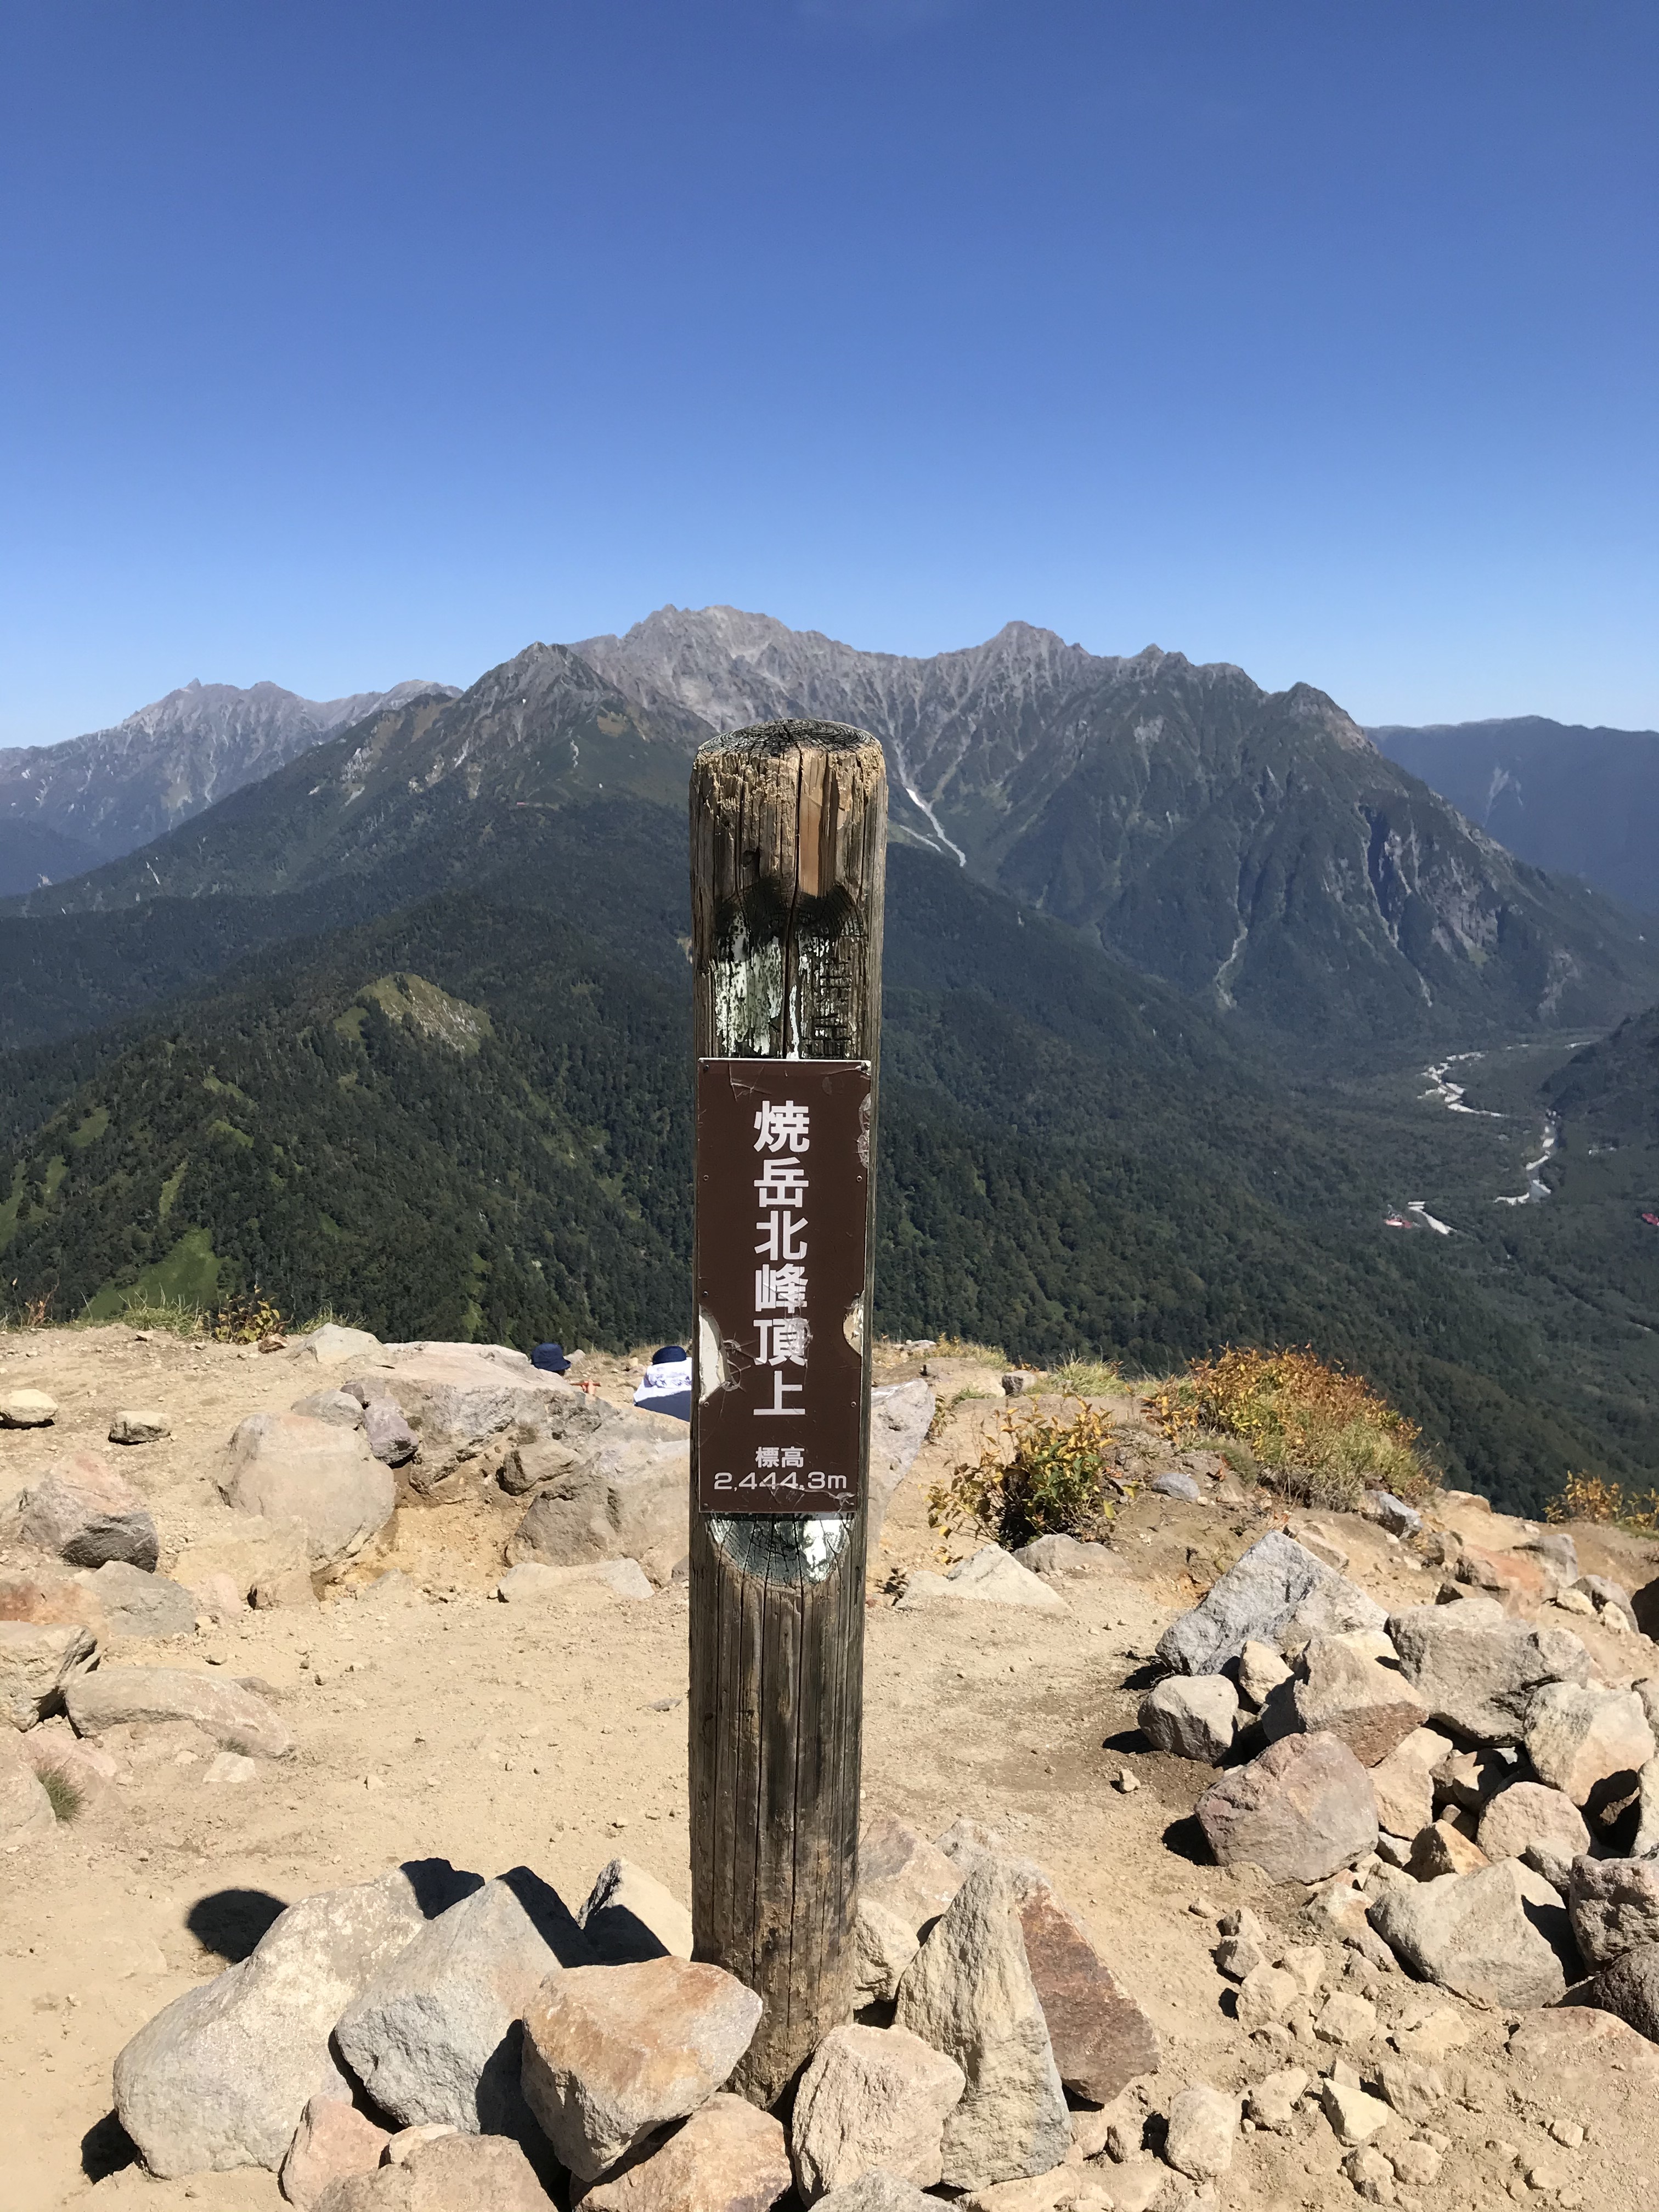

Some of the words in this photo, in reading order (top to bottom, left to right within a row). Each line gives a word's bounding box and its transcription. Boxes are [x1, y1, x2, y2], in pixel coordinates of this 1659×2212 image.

[753, 1100, 810, 1415] 焼岳北峰頂上
[755, 1446, 805, 1468] 標高
[714, 1471, 847, 1492] 2,444.3m
